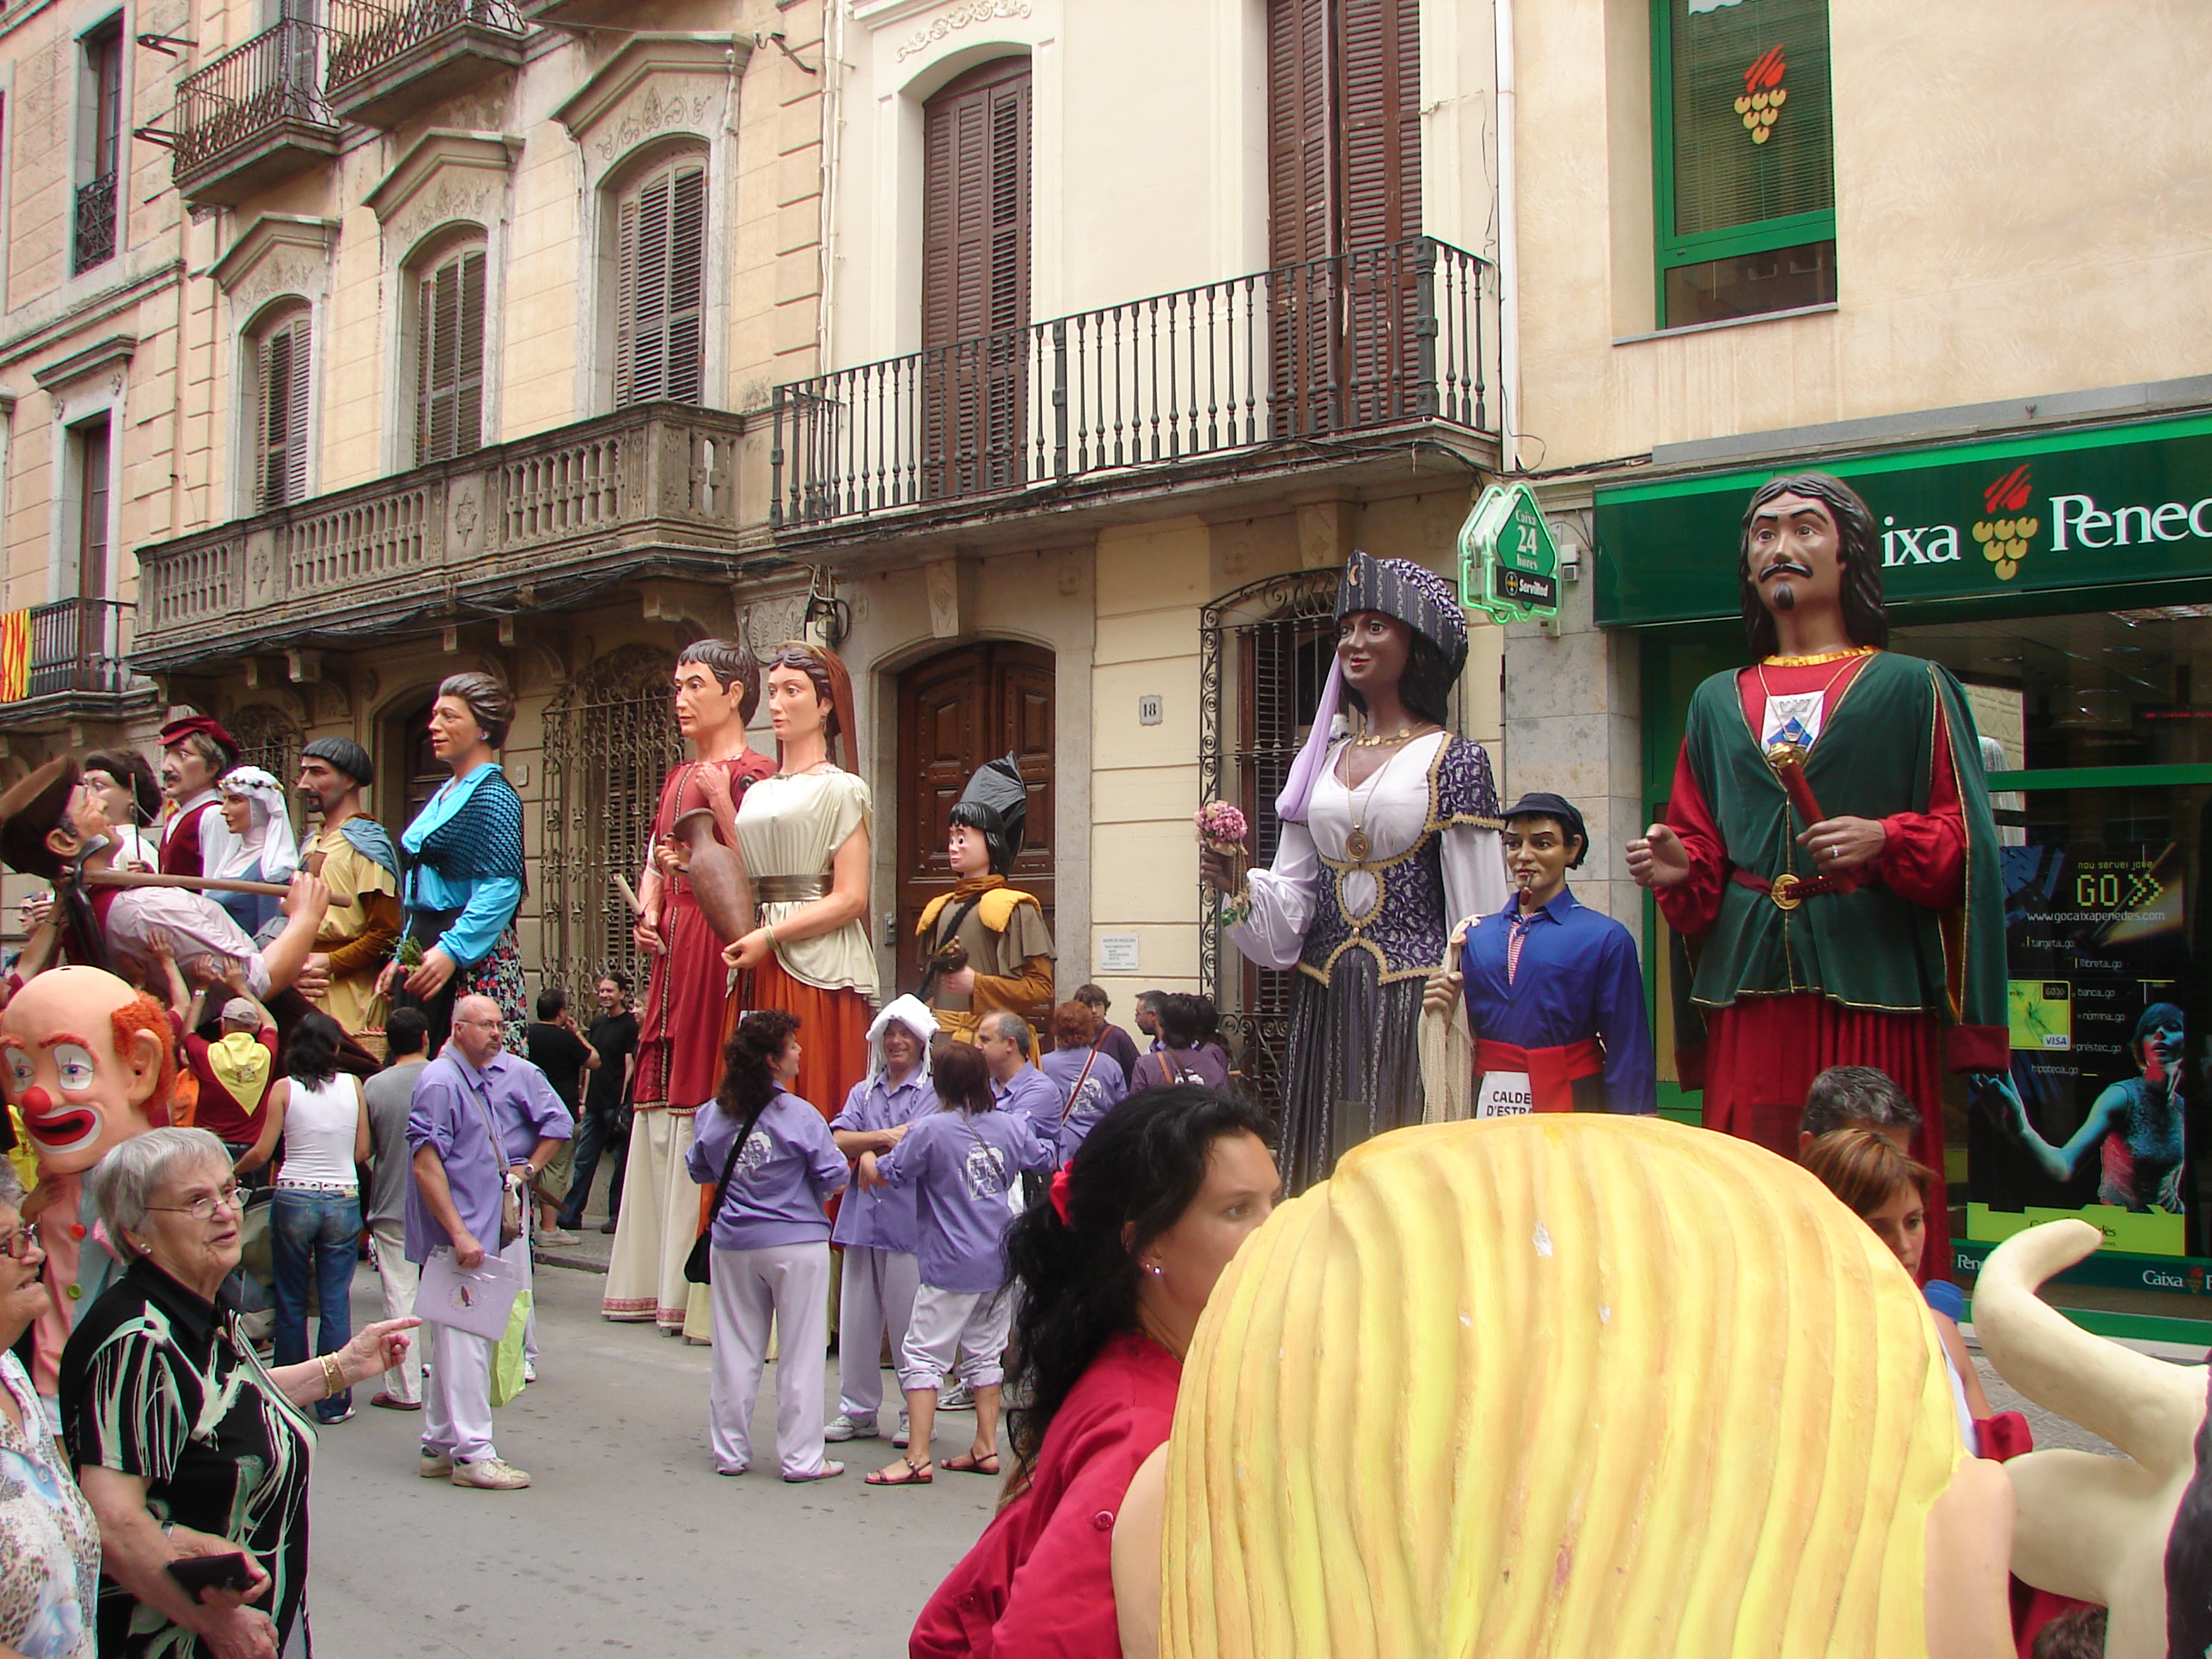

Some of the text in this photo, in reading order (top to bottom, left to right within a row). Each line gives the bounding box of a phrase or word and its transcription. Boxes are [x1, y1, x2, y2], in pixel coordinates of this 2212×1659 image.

[1516, 525, 1538, 556] 24
[1880, 515, 1961, 568] ixa
[1516, 553, 1538, 571] hores
[1519, 579, 1549, 597] ServiRed
[1144, 702, 1156, 717] 18
[2026, 910, 2165, 923] www.gocaixapenedes.com
[2045, 1036, 2067, 1046] VISA
[1493, 1091, 1531, 1104] CALDE
[2142, 1270, 2183, 1287] Caixa
